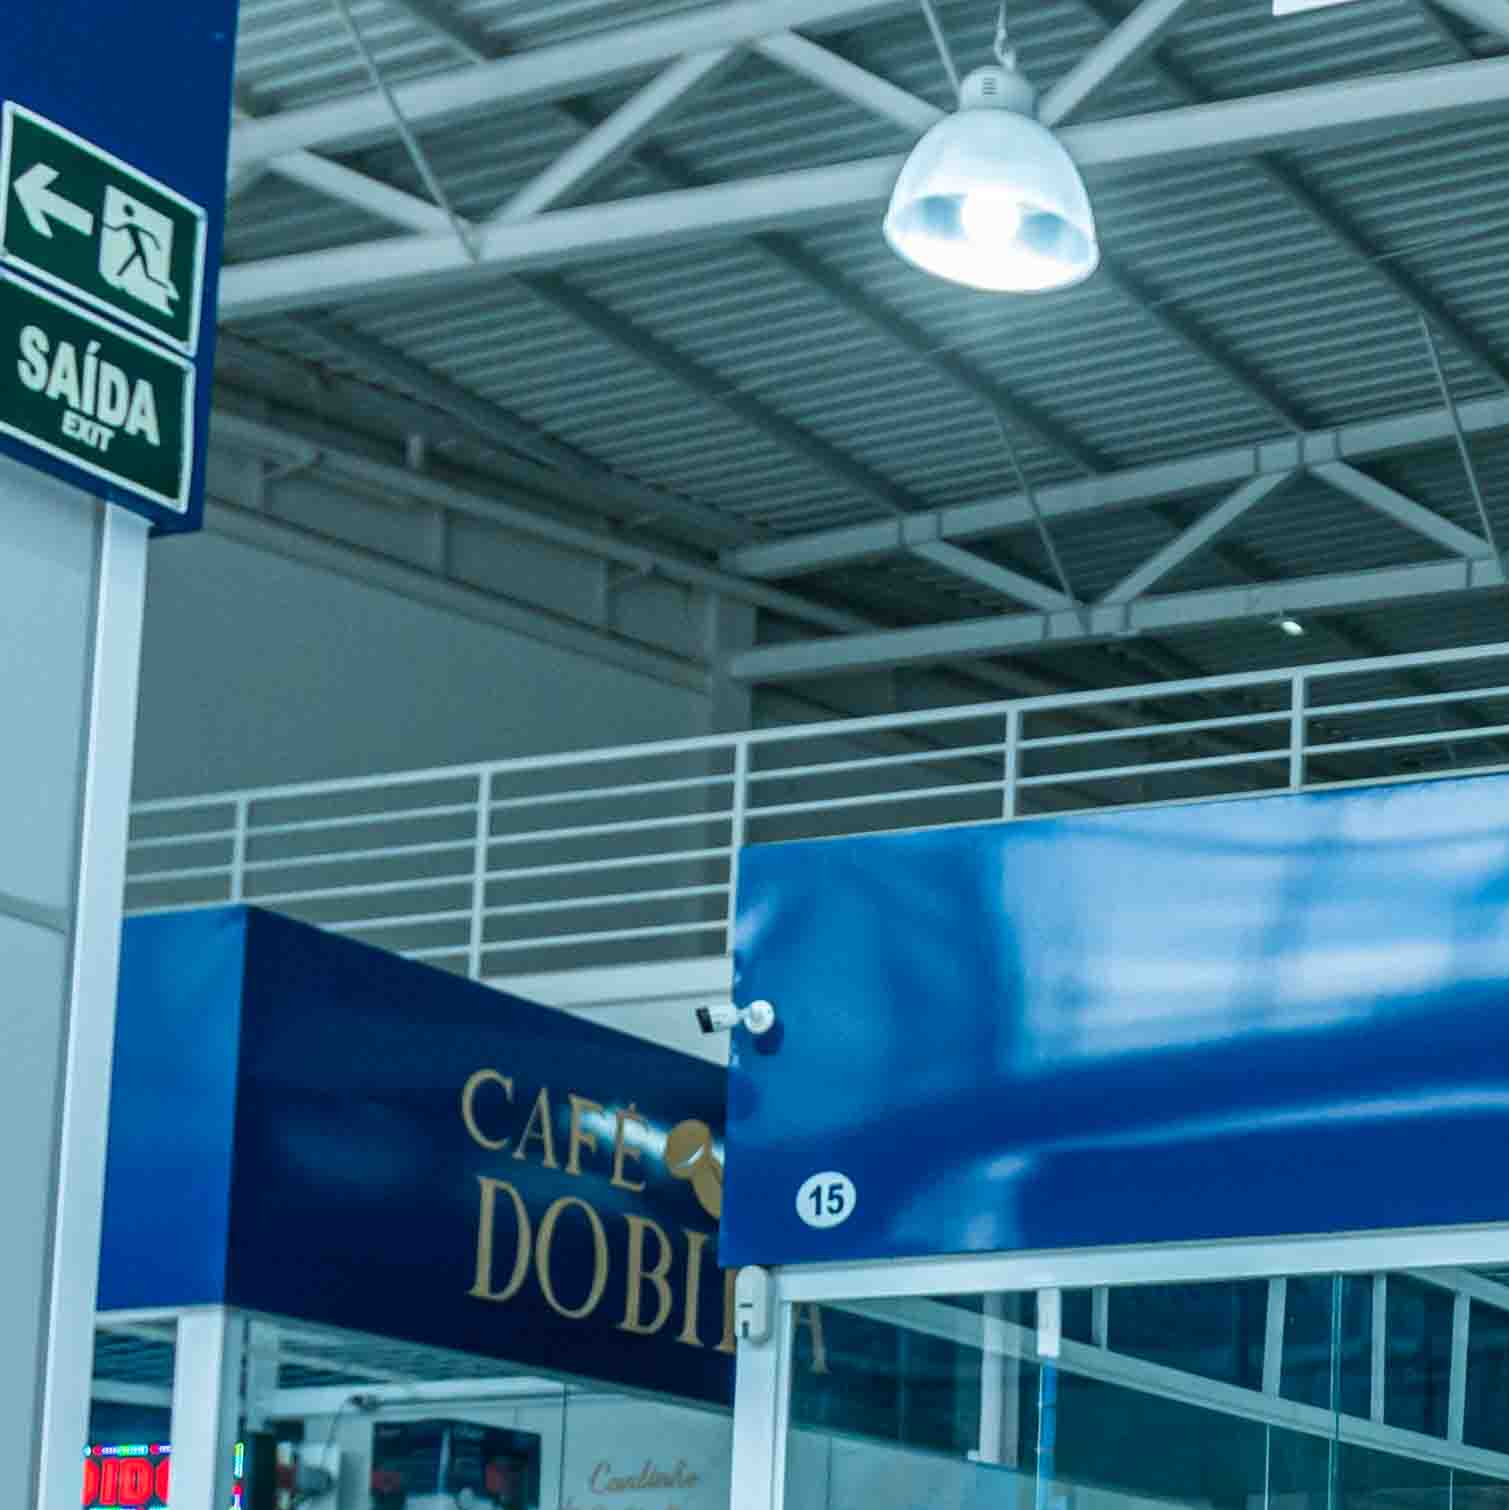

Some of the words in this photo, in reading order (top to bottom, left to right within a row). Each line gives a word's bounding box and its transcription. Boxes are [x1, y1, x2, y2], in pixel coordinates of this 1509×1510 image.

[18, 325, 160, 446] SAÍDA
[61, 410, 115, 452] EXIT
[462, 1068, 648, 1192] CAFÉ
[809, 1183, 844, 1215] 15
